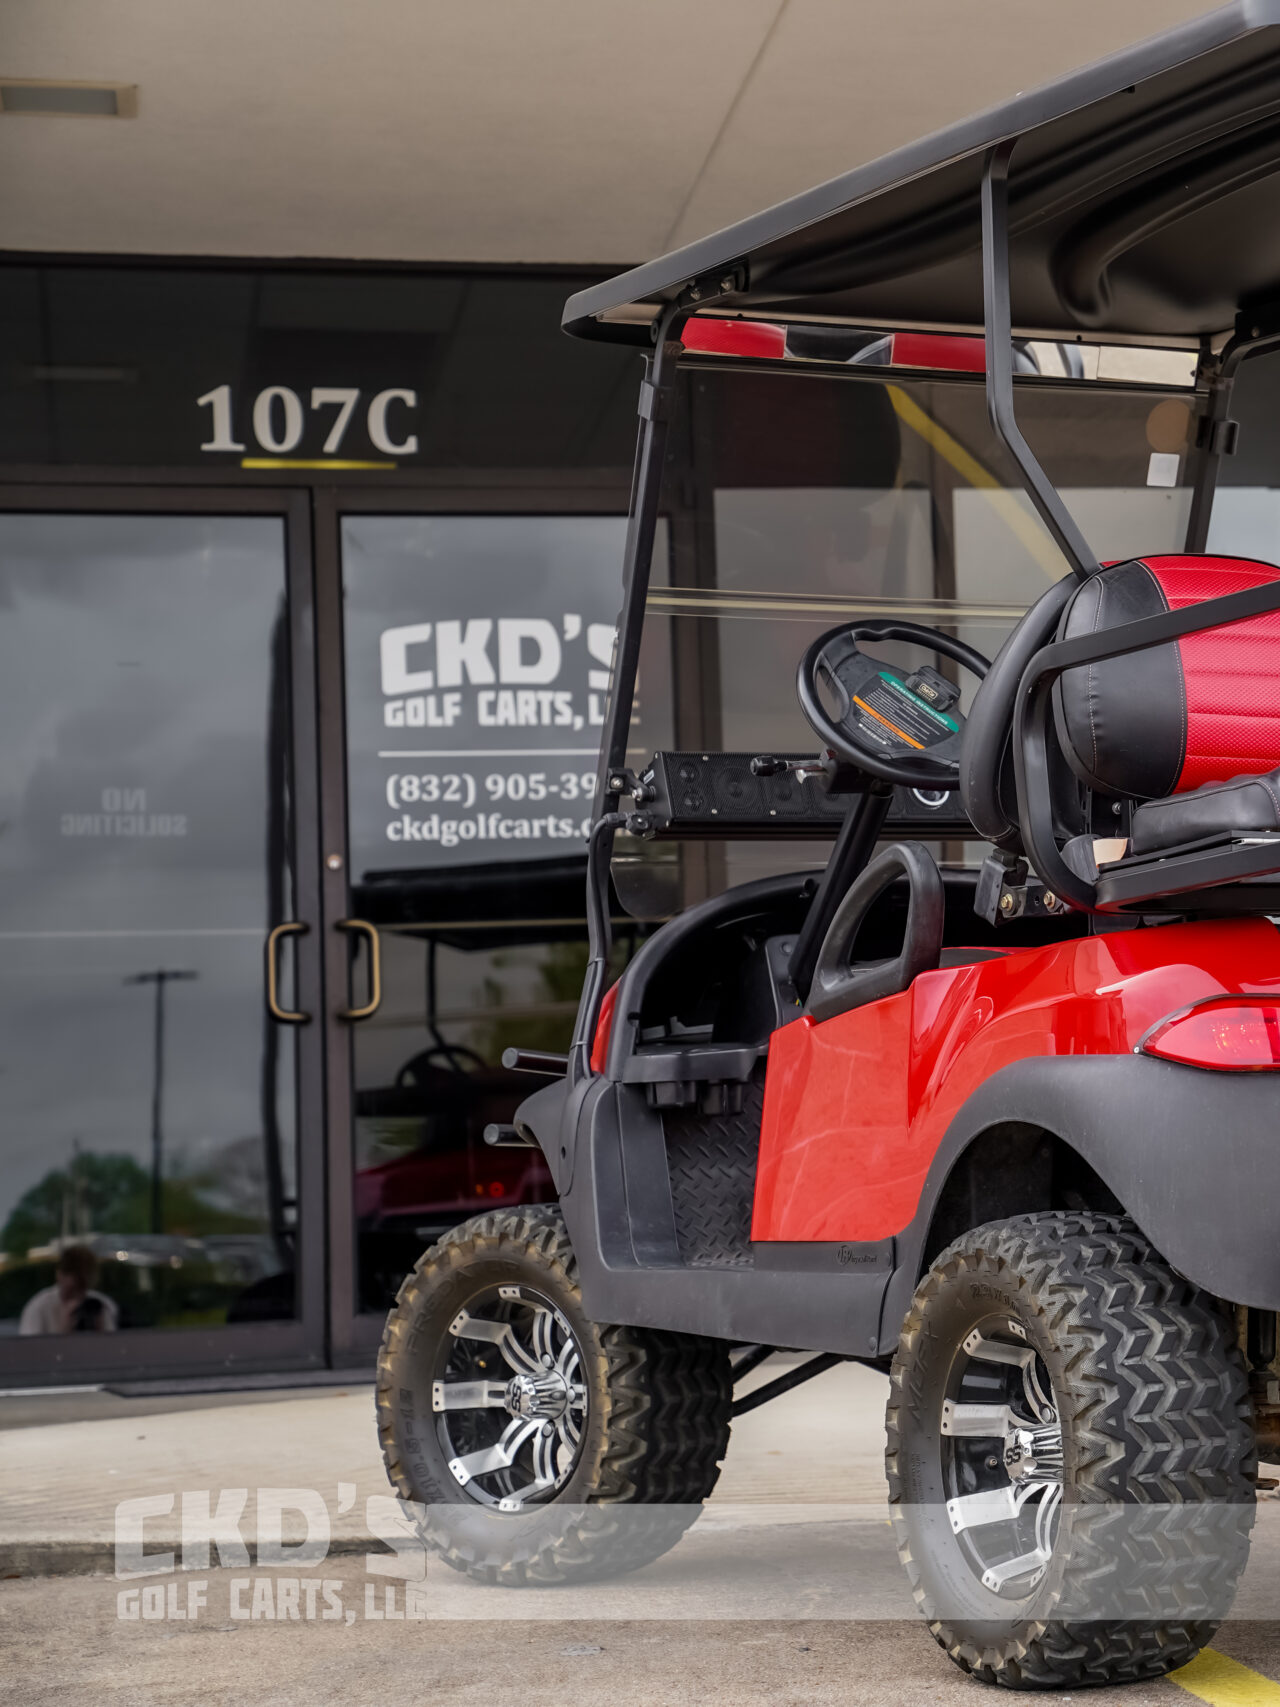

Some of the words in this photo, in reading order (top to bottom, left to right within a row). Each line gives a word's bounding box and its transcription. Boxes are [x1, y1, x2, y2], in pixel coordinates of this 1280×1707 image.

[197, 384, 418, 455] 107C
[380, 613, 640, 696] CKD'S
[384, 693, 462, 727] GOLF
[477, 690, 583, 731] CARTS,
[386, 773, 476, 809] (832)
[485, 773, 599, 801] 905-39
[386, 813, 594, 847] ckdgolfcarts.c
